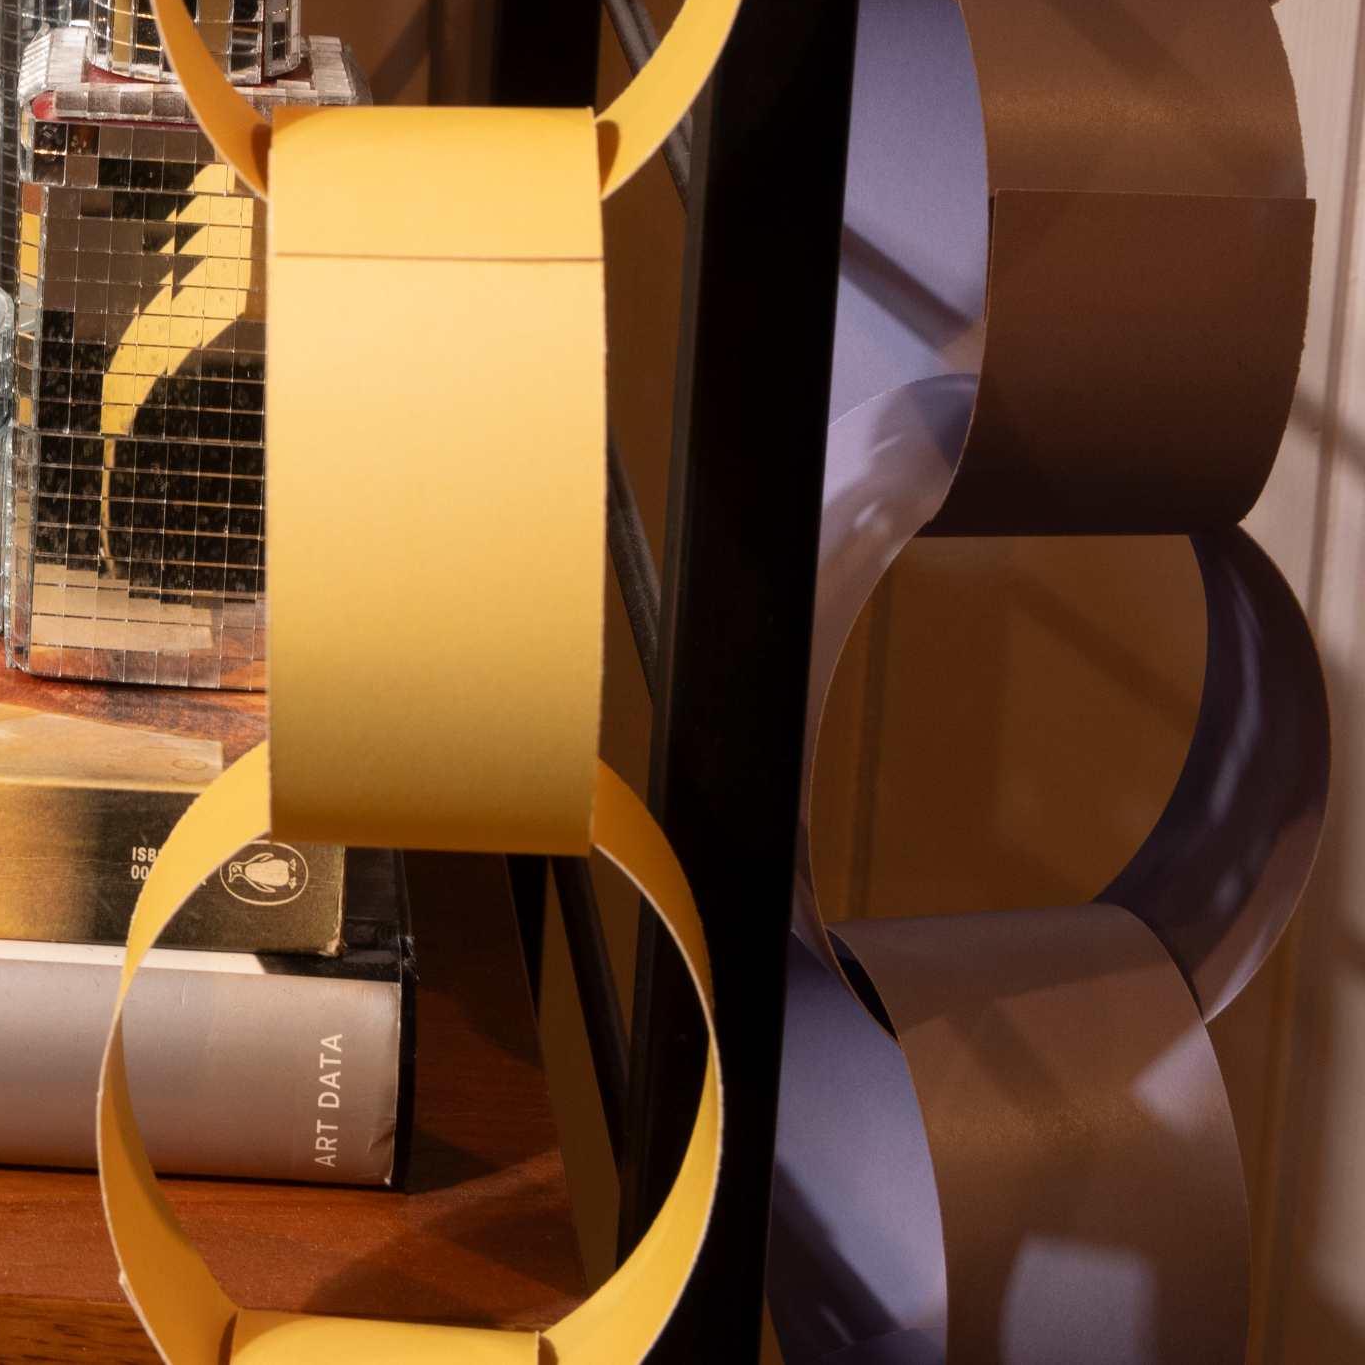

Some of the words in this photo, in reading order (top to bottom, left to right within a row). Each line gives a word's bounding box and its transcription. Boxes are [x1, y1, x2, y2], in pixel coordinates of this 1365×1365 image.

[131, 846, 162, 863] ISB
[317, 1033, 344, 1109] DATA
[314, 1119, 339, 1168] ART
